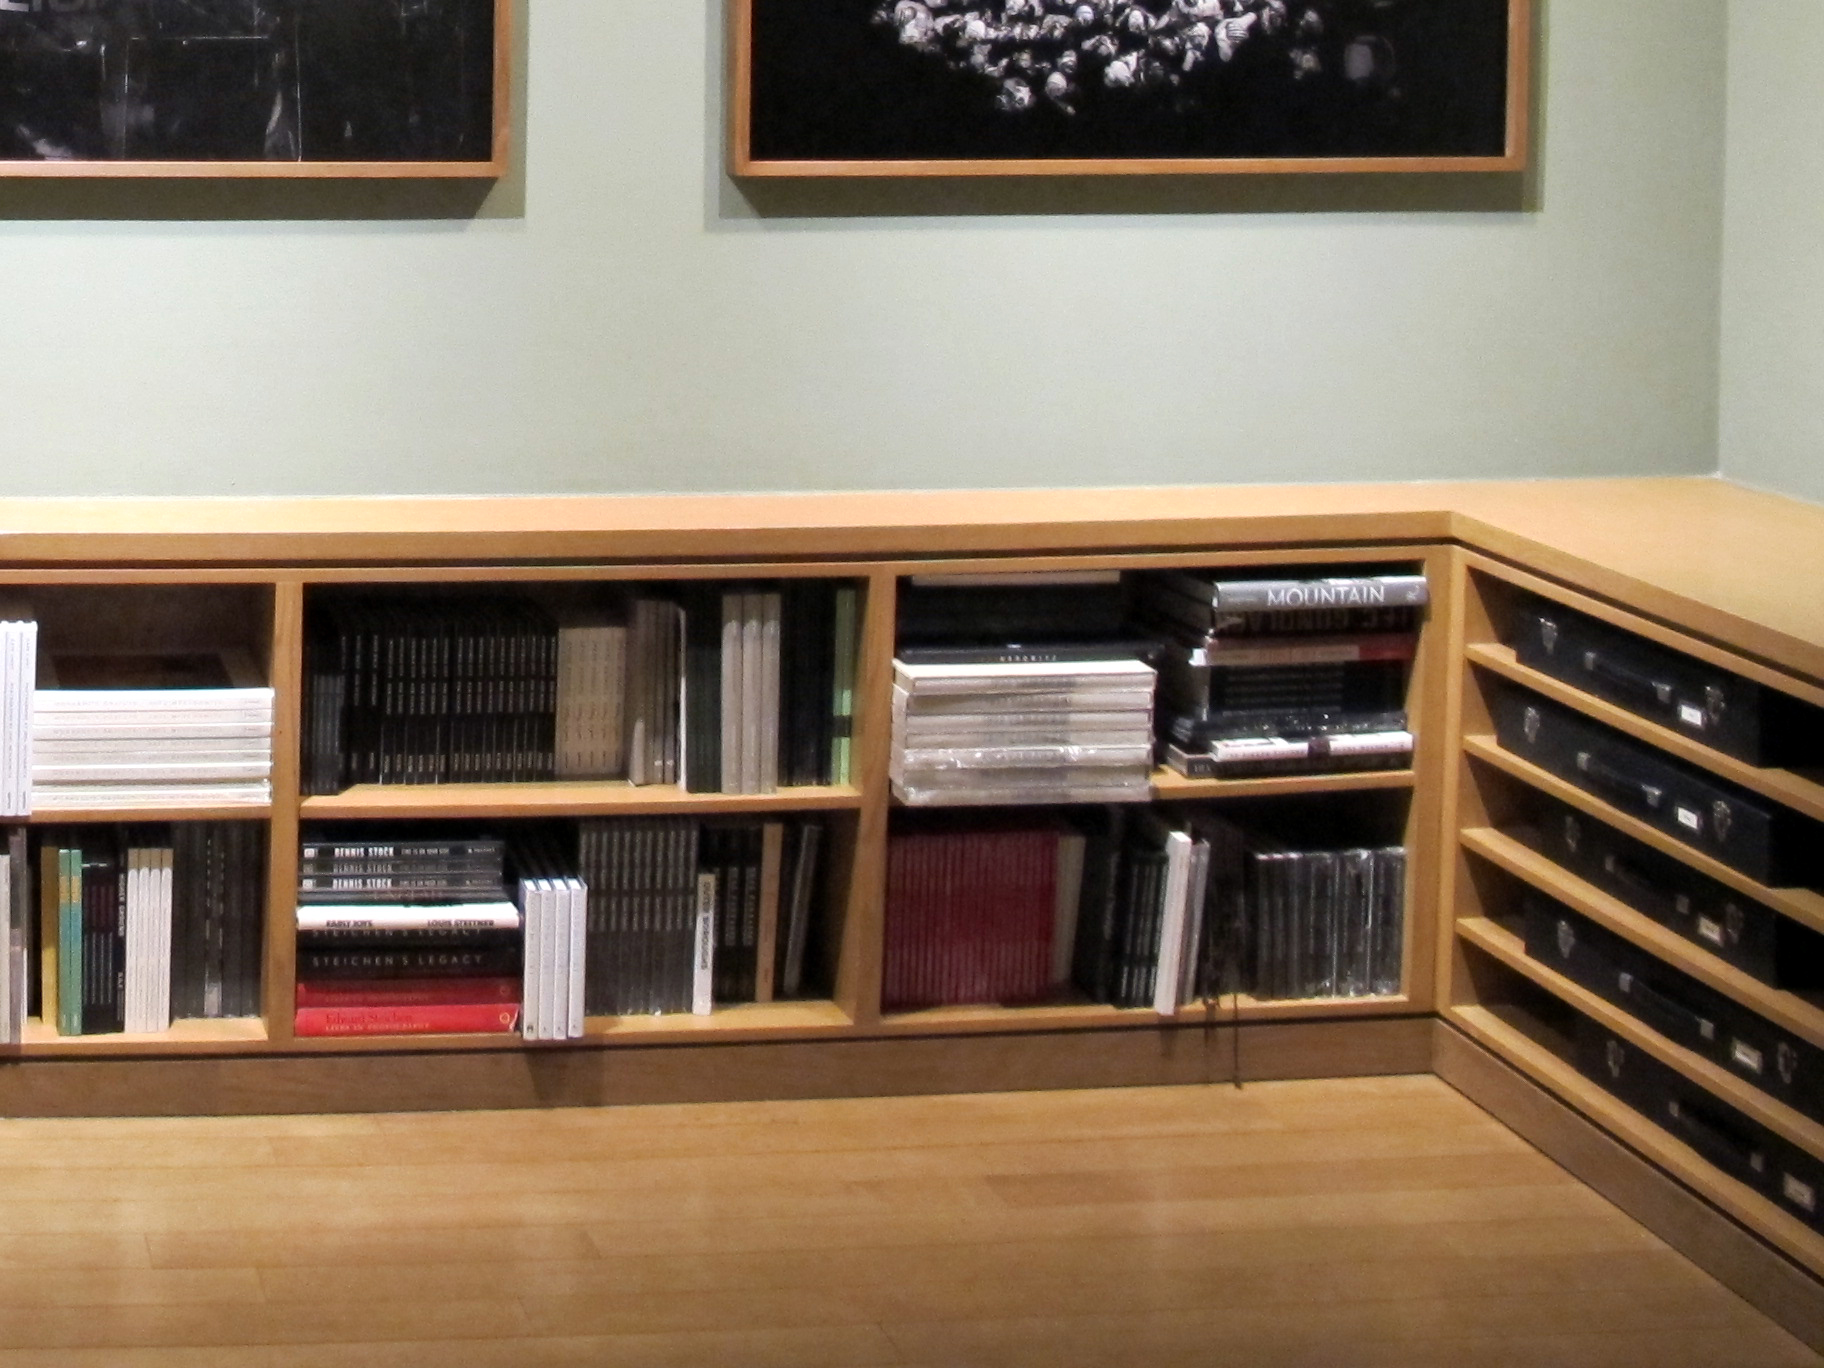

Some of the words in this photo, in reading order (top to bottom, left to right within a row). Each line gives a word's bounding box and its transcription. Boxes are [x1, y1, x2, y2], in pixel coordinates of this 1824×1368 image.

[1267, 585, 1386, 607] MOUNTAIN
[334, 847, 364, 857] DENNIS
[368, 846, 394, 857] STOCK
[332, 878, 363, 889] DENNIS
[366, 878, 392, 889] STOCK
[418, 955, 483, 965] LEGACY
